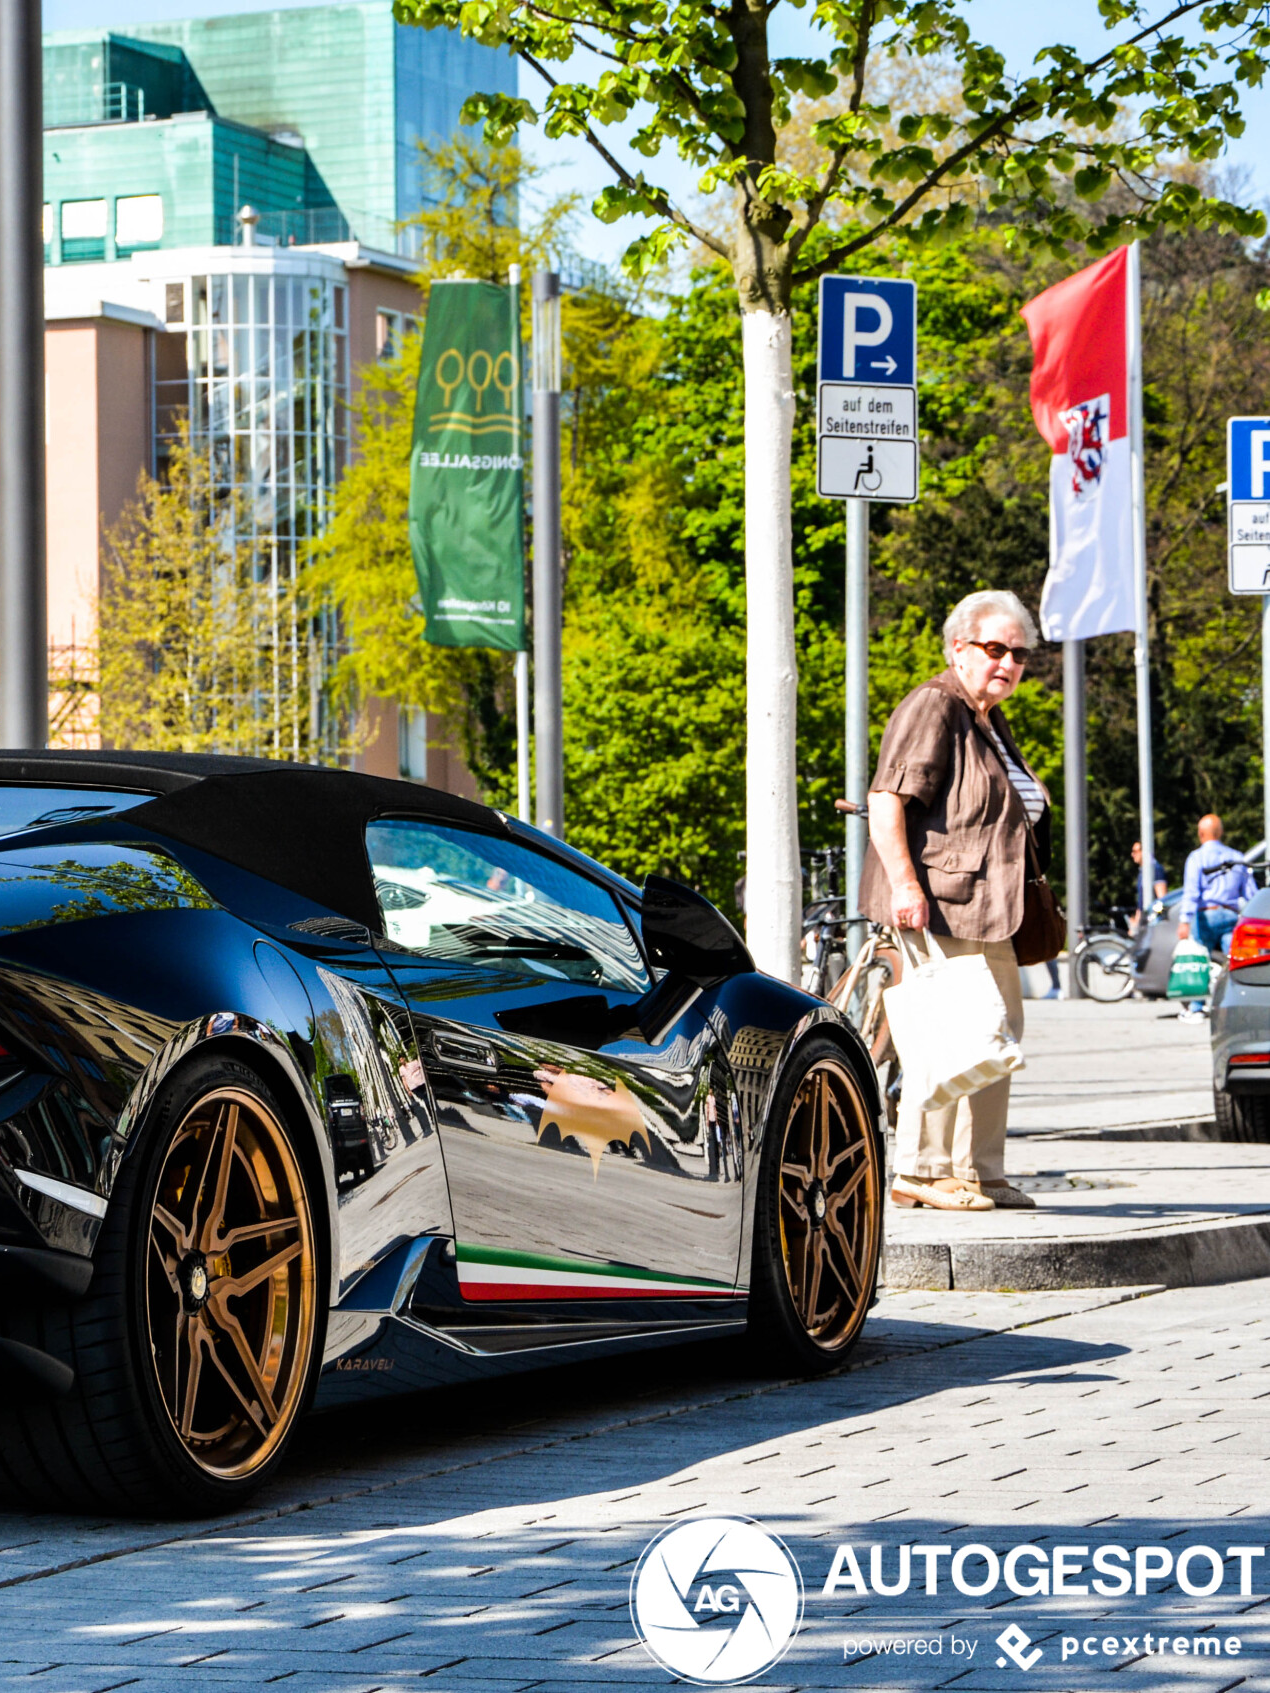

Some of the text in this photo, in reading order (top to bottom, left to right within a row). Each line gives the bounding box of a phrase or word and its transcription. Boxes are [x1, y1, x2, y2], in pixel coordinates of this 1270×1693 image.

[843, 292, 893, 378] P
[843, 397, 893, 414] auf dem
[826, 417, 909, 436] Seitenstreifen
